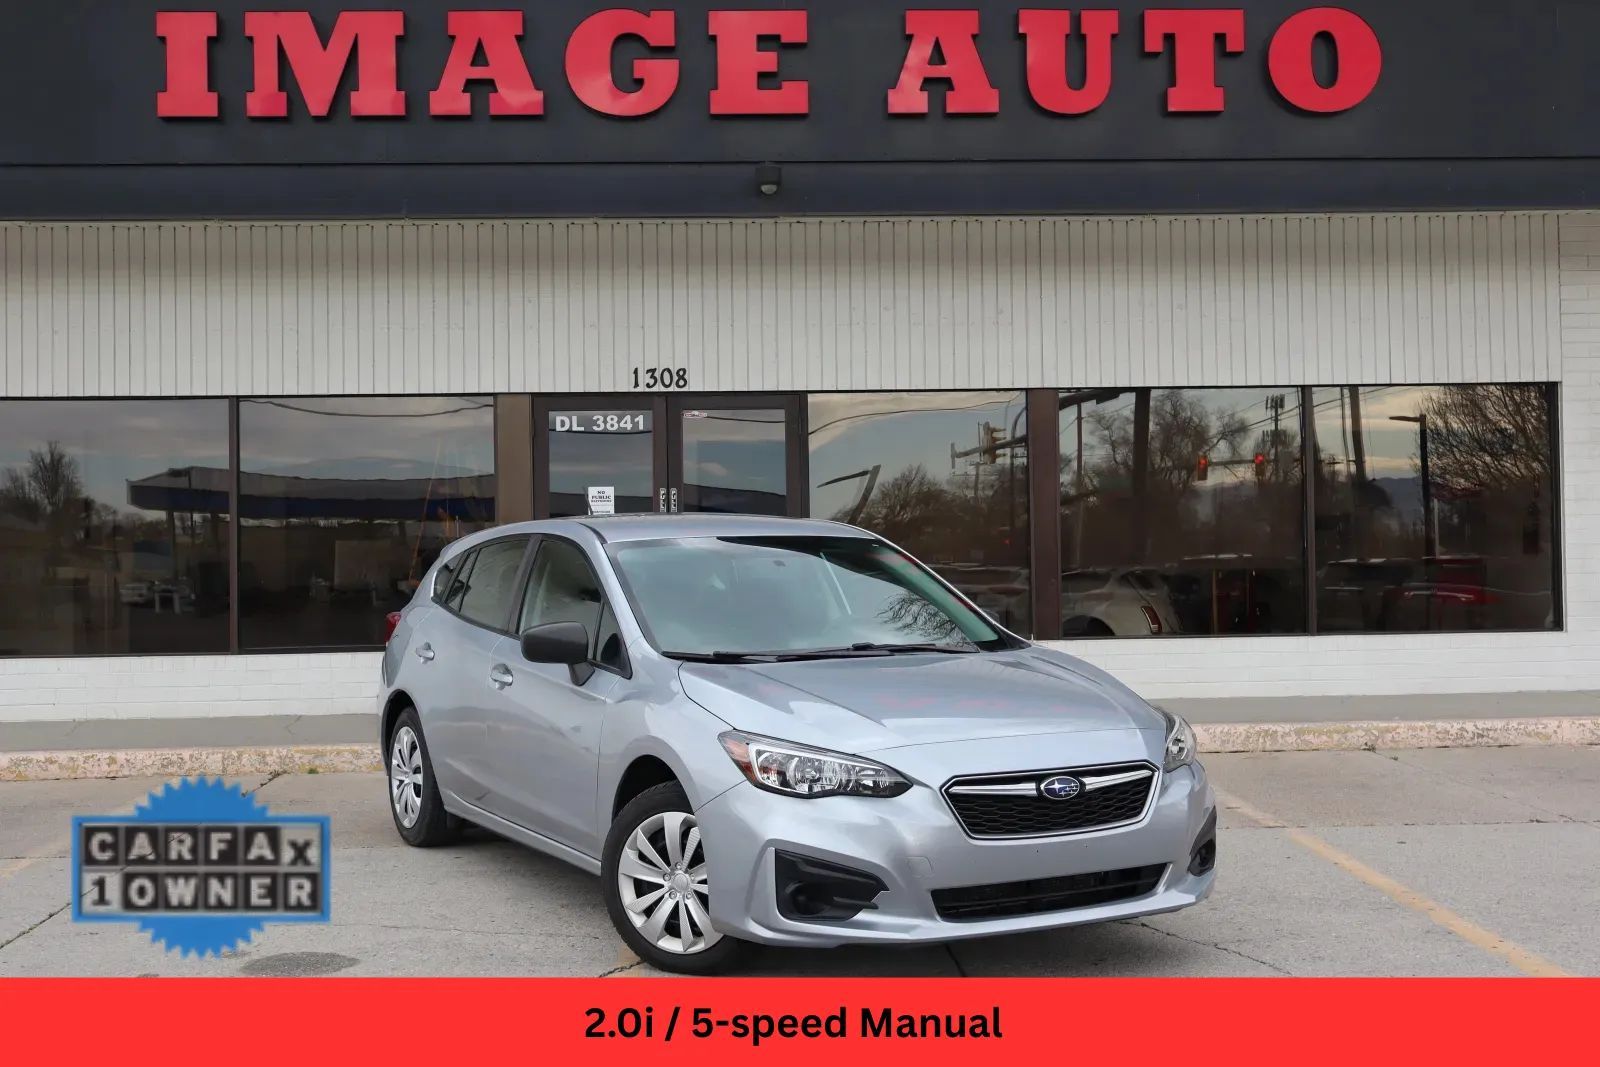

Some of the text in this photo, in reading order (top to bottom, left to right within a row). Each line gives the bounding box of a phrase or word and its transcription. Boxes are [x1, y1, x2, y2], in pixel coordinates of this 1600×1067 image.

[157, 7, 1382, 117] IMAGE AUTO
[633, 367, 688, 389] 1308
[555, 414, 645, 432] DL 3841
